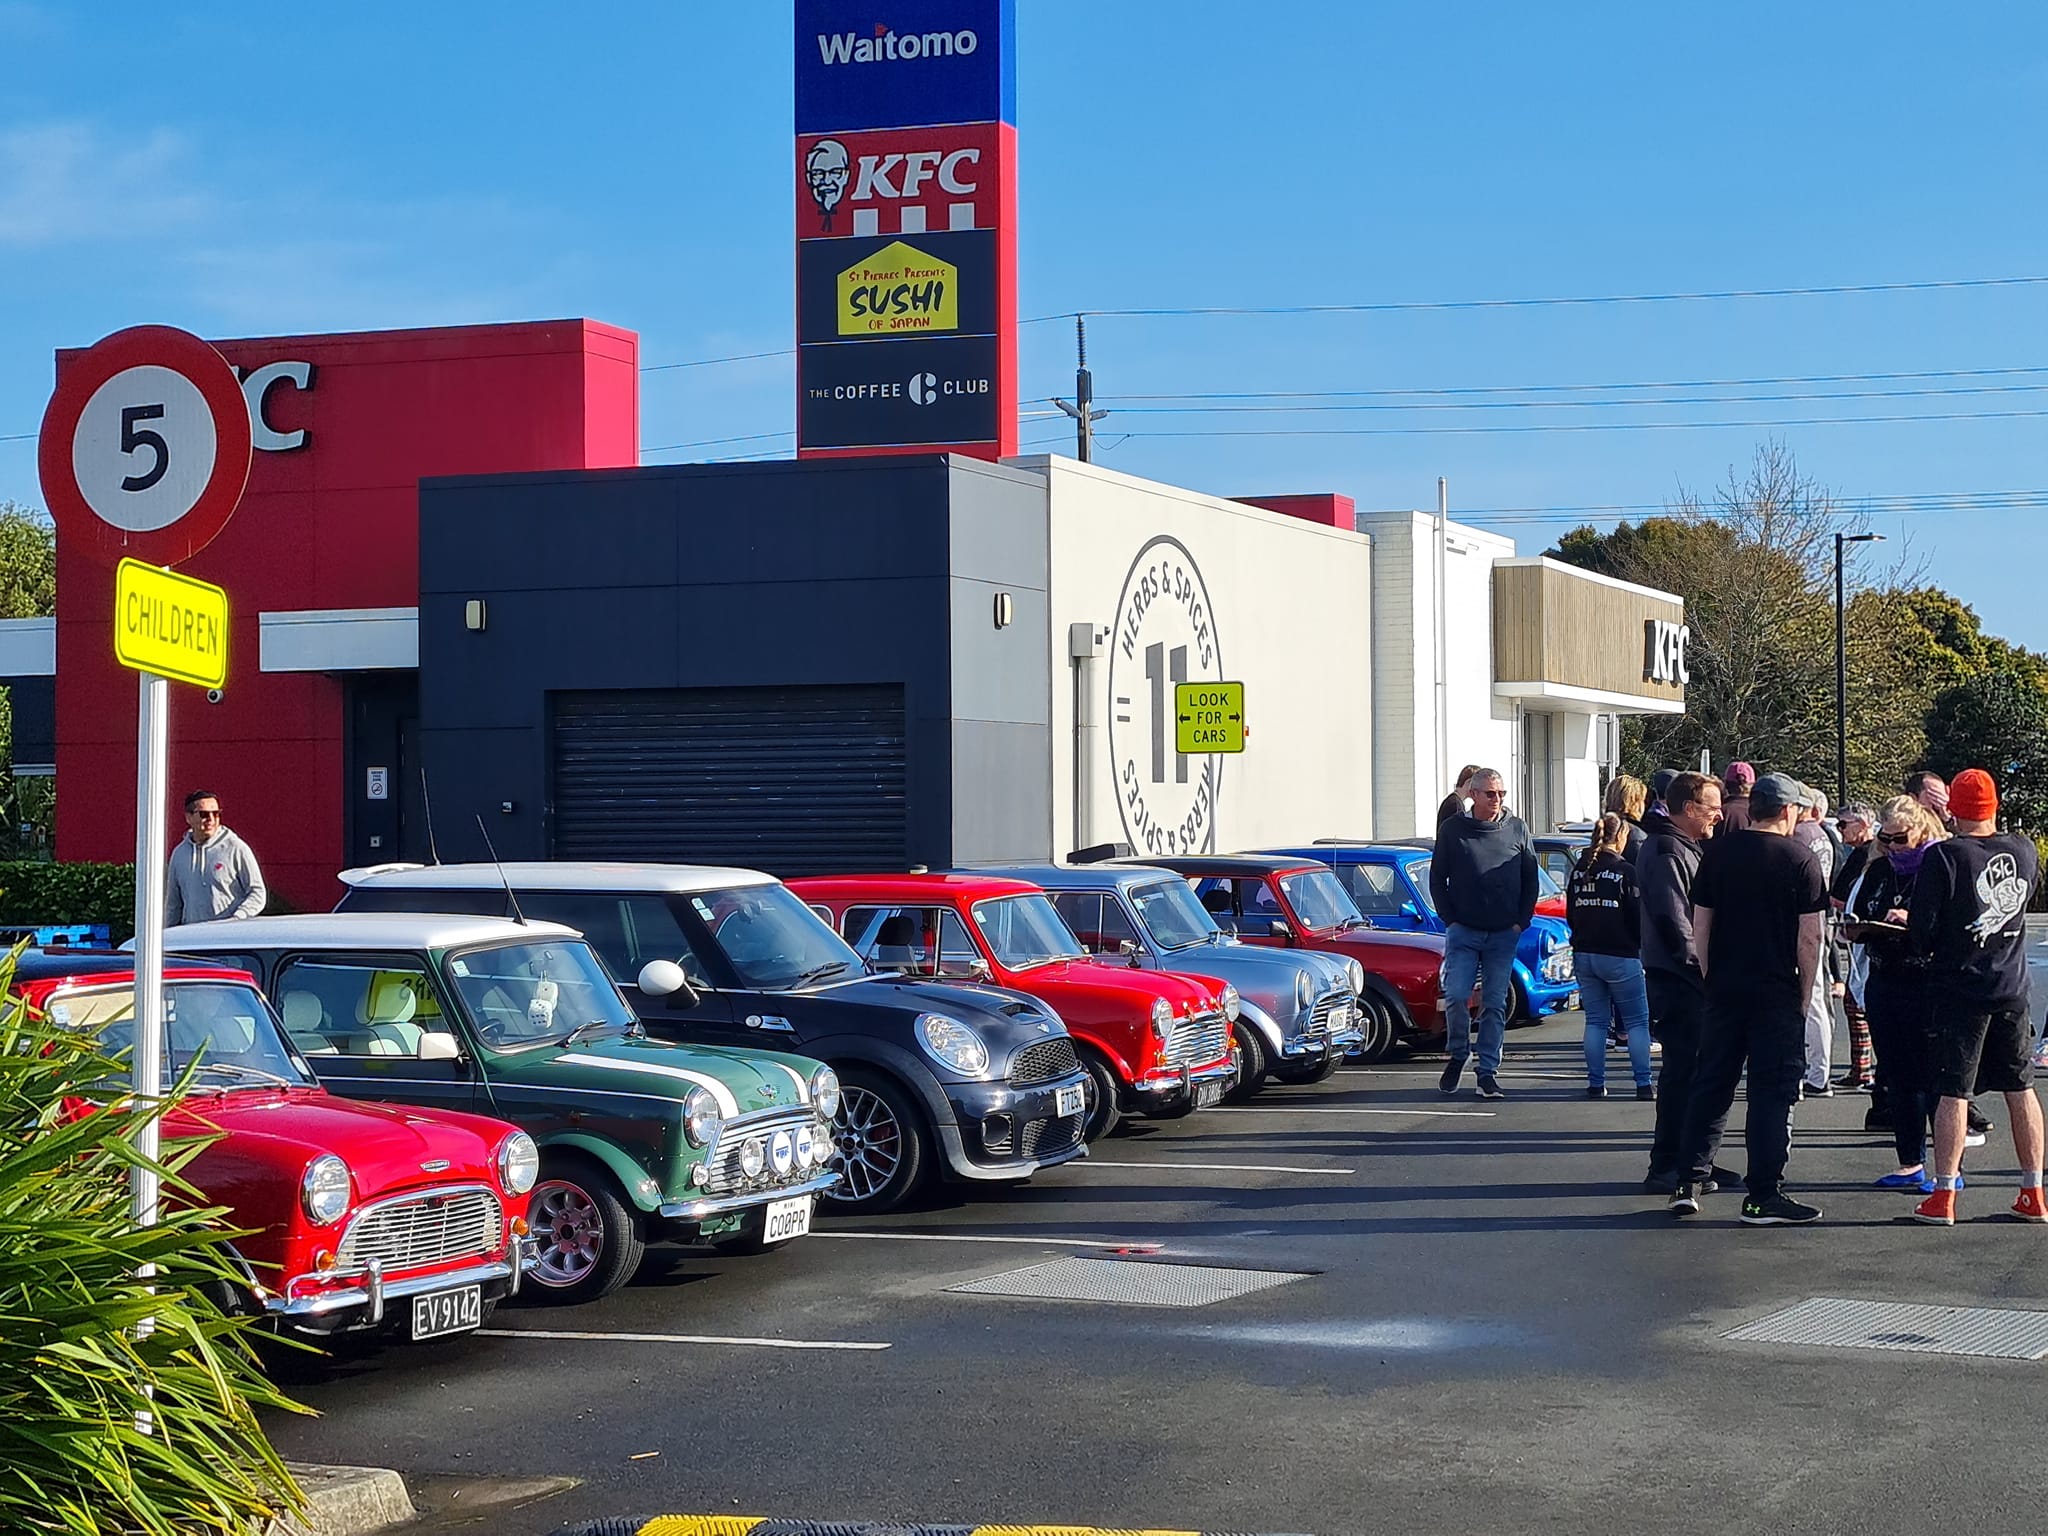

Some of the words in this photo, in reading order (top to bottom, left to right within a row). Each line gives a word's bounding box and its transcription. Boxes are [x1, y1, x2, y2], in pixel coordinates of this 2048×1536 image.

[817, 29, 977, 65] Waitomo
[850, 148, 980, 201] KFC
[849, 280, 944, 317] SUSHI
[868, 319, 884, 330] OF
[890, 317, 930, 329] JAPAN
[809, 389, 829, 398] THE
[834, 384, 901, 400] COFFEE
[943, 379, 989, 394] CLUB
[120, 403, 170, 492] 5
[126, 591, 219, 657] CHILDREN
[1122, 566, 1158, 661] HERBS
[1162, 560, 1171, 594] &
[1175, 566, 1212, 670] SPICES
[1653, 619, 1690, 684] KFC
[1190, 693, 1229, 707] LOOK
[1197, 711, 1222, 725] FOR
[1193, 729, 1226, 743] CARS
[1582, 883, 1595, 892] all
